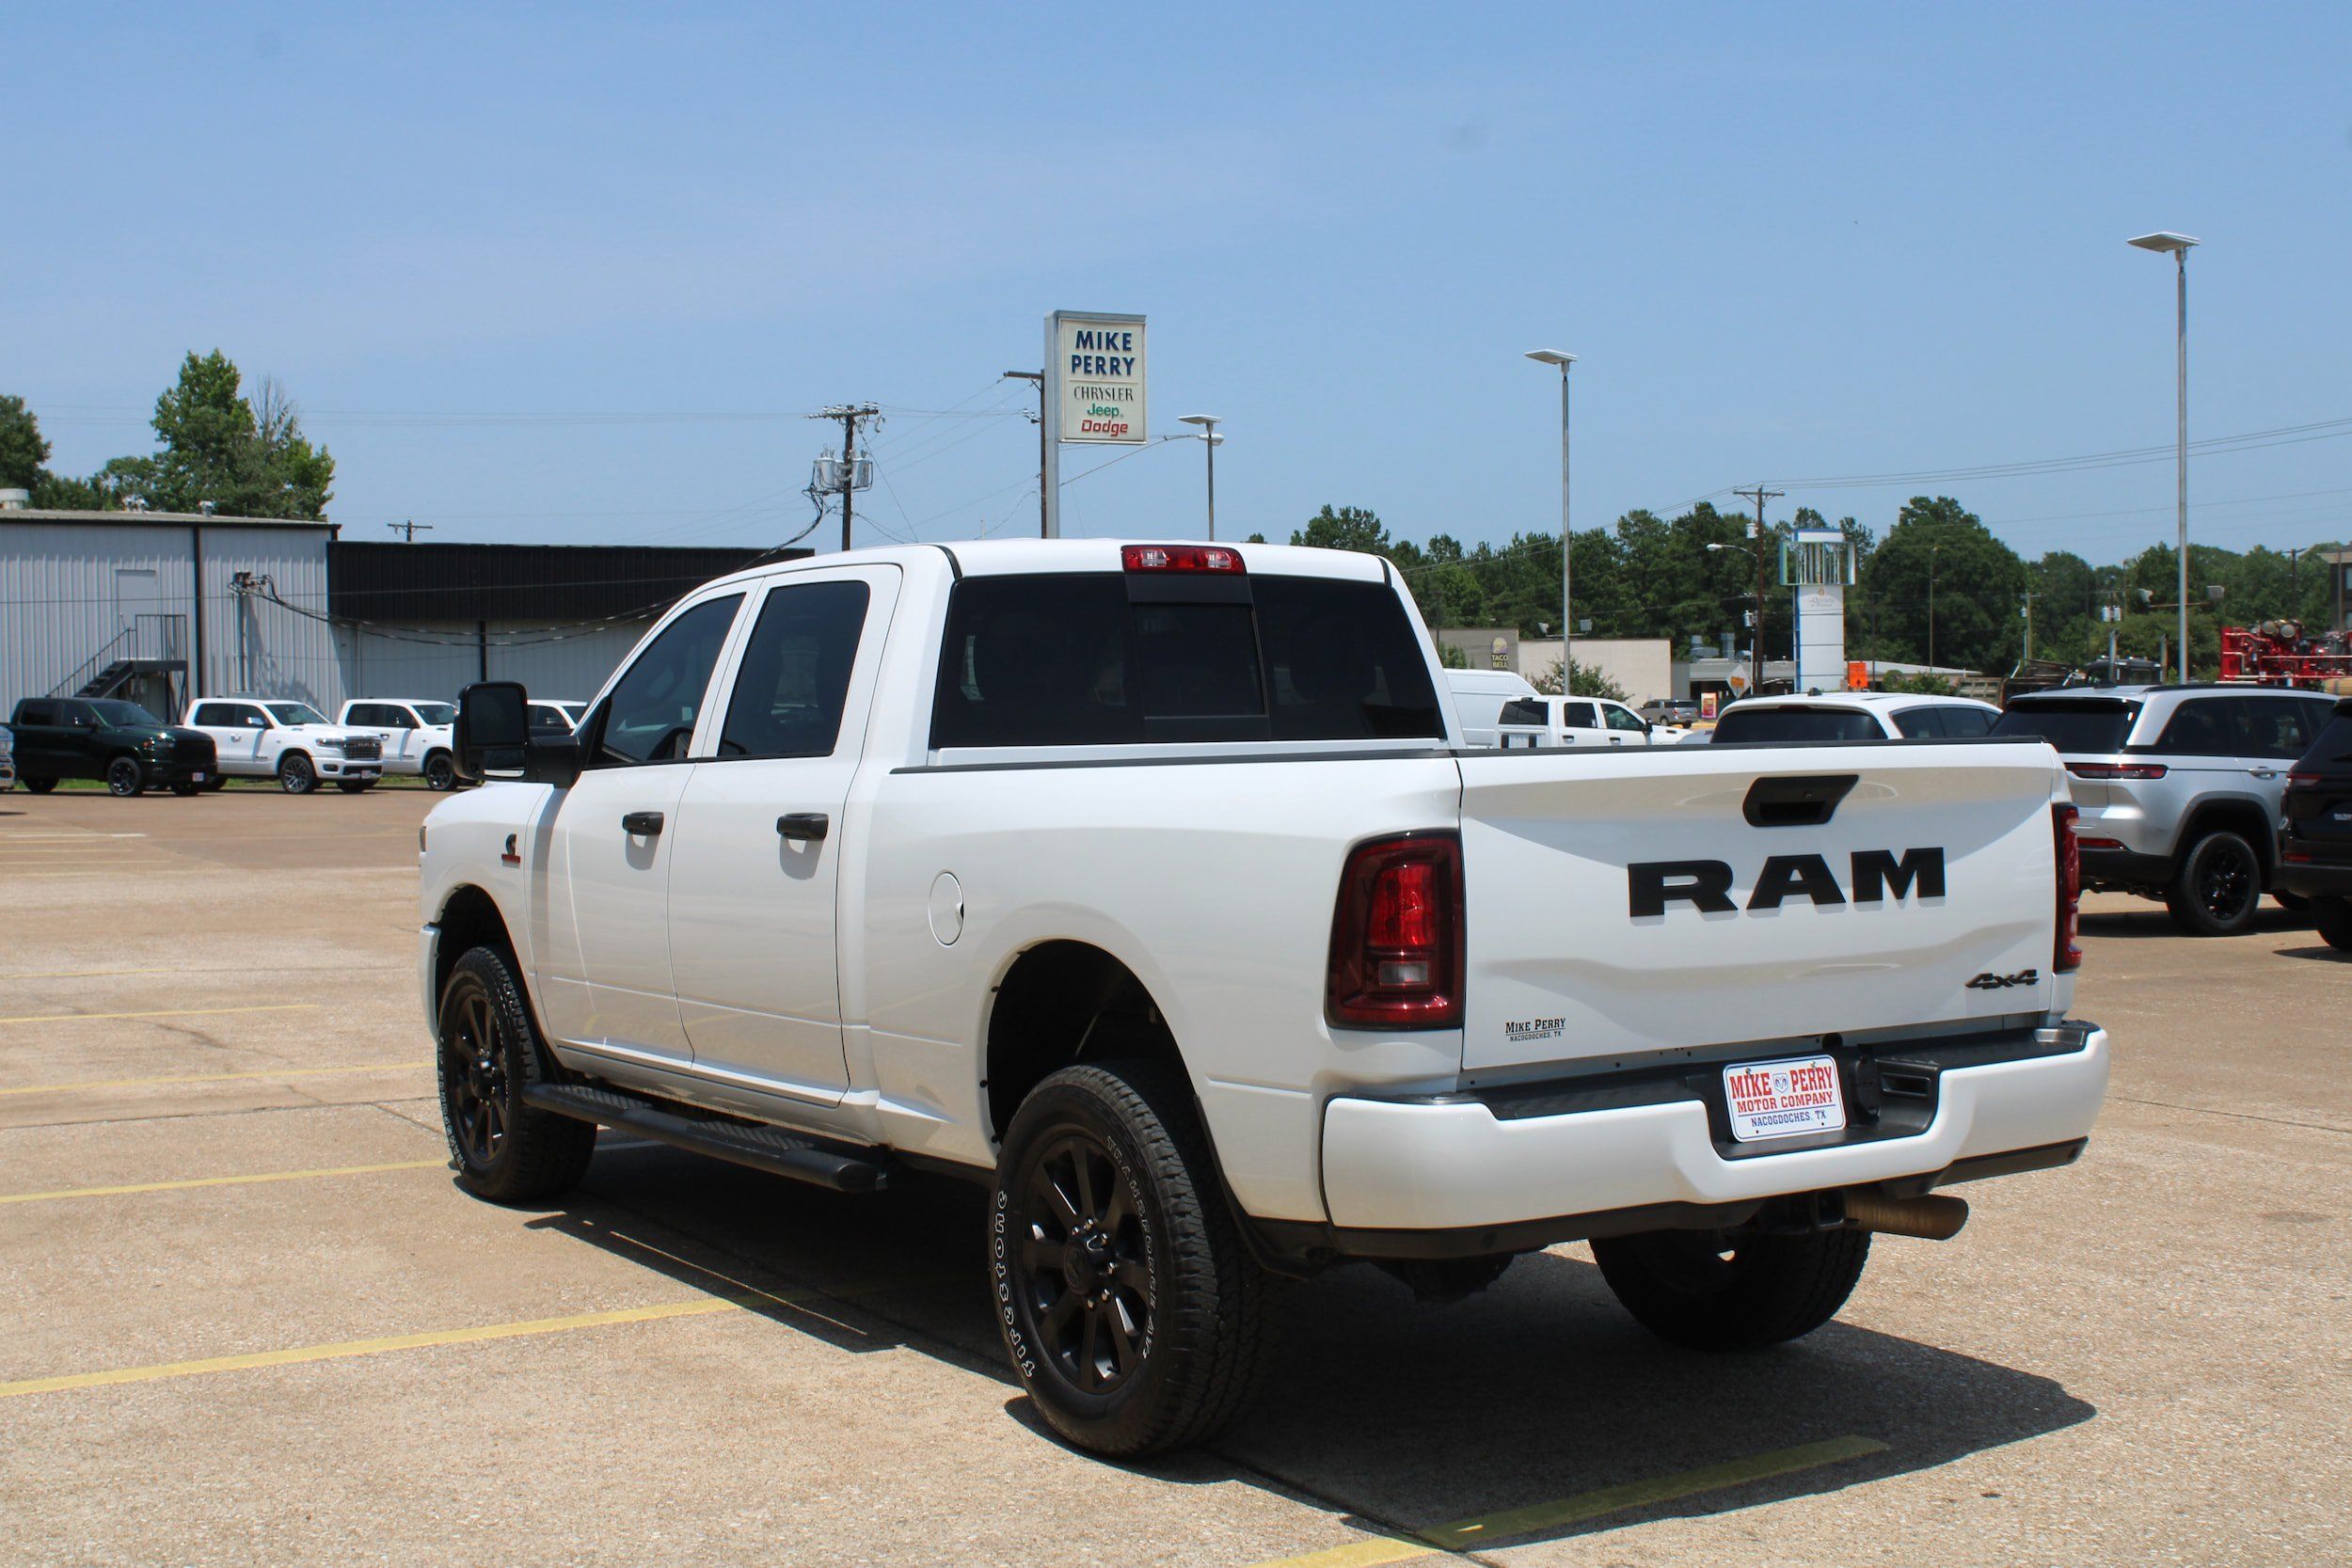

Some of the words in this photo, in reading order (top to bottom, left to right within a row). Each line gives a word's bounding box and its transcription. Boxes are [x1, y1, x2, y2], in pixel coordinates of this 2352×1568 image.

[1075, 330, 1132, 351] MIKE
[1072, 355, 1135, 376] PERRY
[1073, 386, 1134, 402] CHRYSLER
[1087, 403, 1120, 419] Jeep
[1081, 420, 1129, 437] Dodge
[1628, 847, 1946, 917] RAM
[1964, 969, 2040, 990] 4x4
[1729, 1072, 1772, 1100] MIKE
[1789, 1066, 1834, 1093] PERRY
[1737, 1097, 1778, 1114] MOTOR
[1781, 1091, 1834, 1109] COMPANY
[1815, 1109, 1828, 1120] TX
